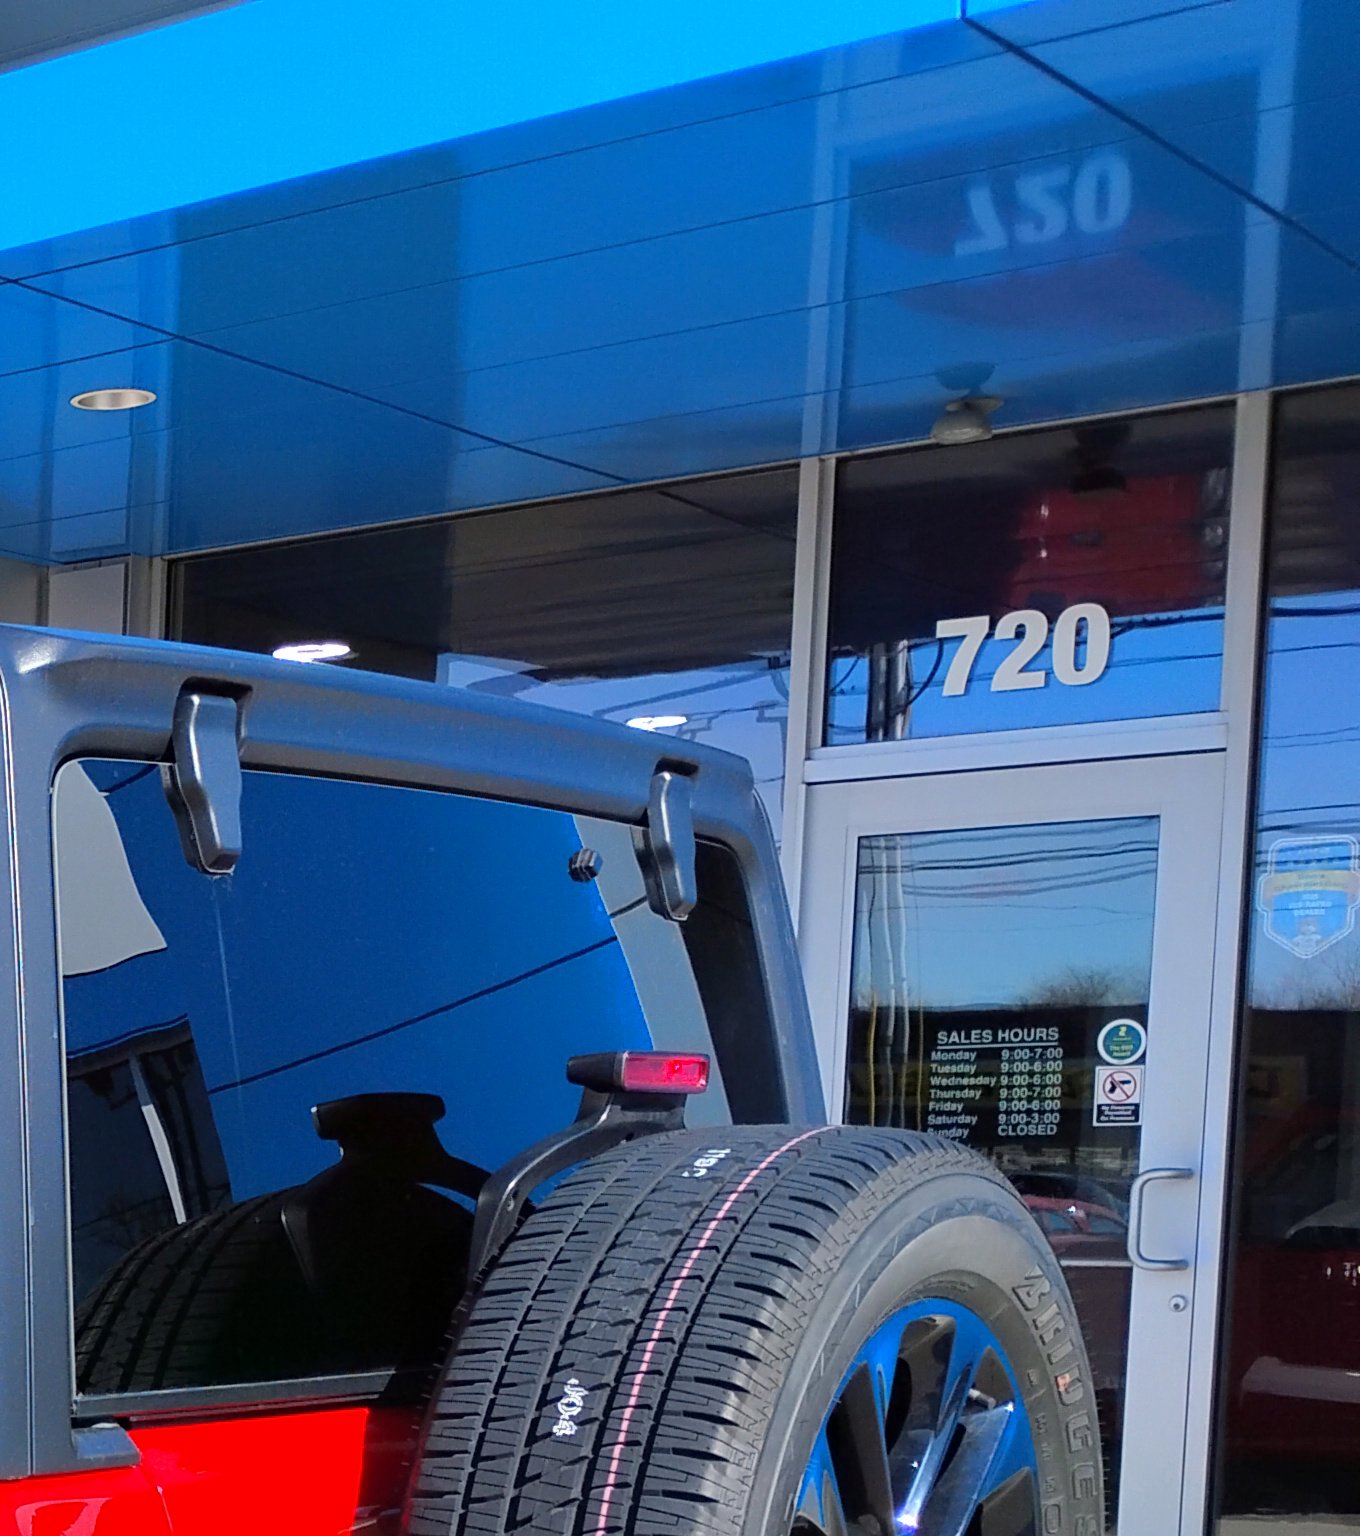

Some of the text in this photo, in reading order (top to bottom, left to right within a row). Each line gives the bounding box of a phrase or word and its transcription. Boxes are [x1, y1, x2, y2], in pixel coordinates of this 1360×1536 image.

[935, 602, 1112, 696] 720
[937, 1027, 1059, 1045] SALES HOURS
[931, 1047, 1063, 1062] Monday 9:00-7:00
[930, 1061, 1062, 1075] Tuesday 9:00-6:00
[930, 1073, 1062, 1087] Wednesday 9:00-6:00
[929, 1086, 1061, 1100] Thursday 9:00-7:00
[928, 1099, 1061, 1113] Friday 9:00-6:00
[927, 1112, 1060, 1125] Saturday 9:00-3:00
[927, 1124, 1058, 1139] Sunday CLOSED
